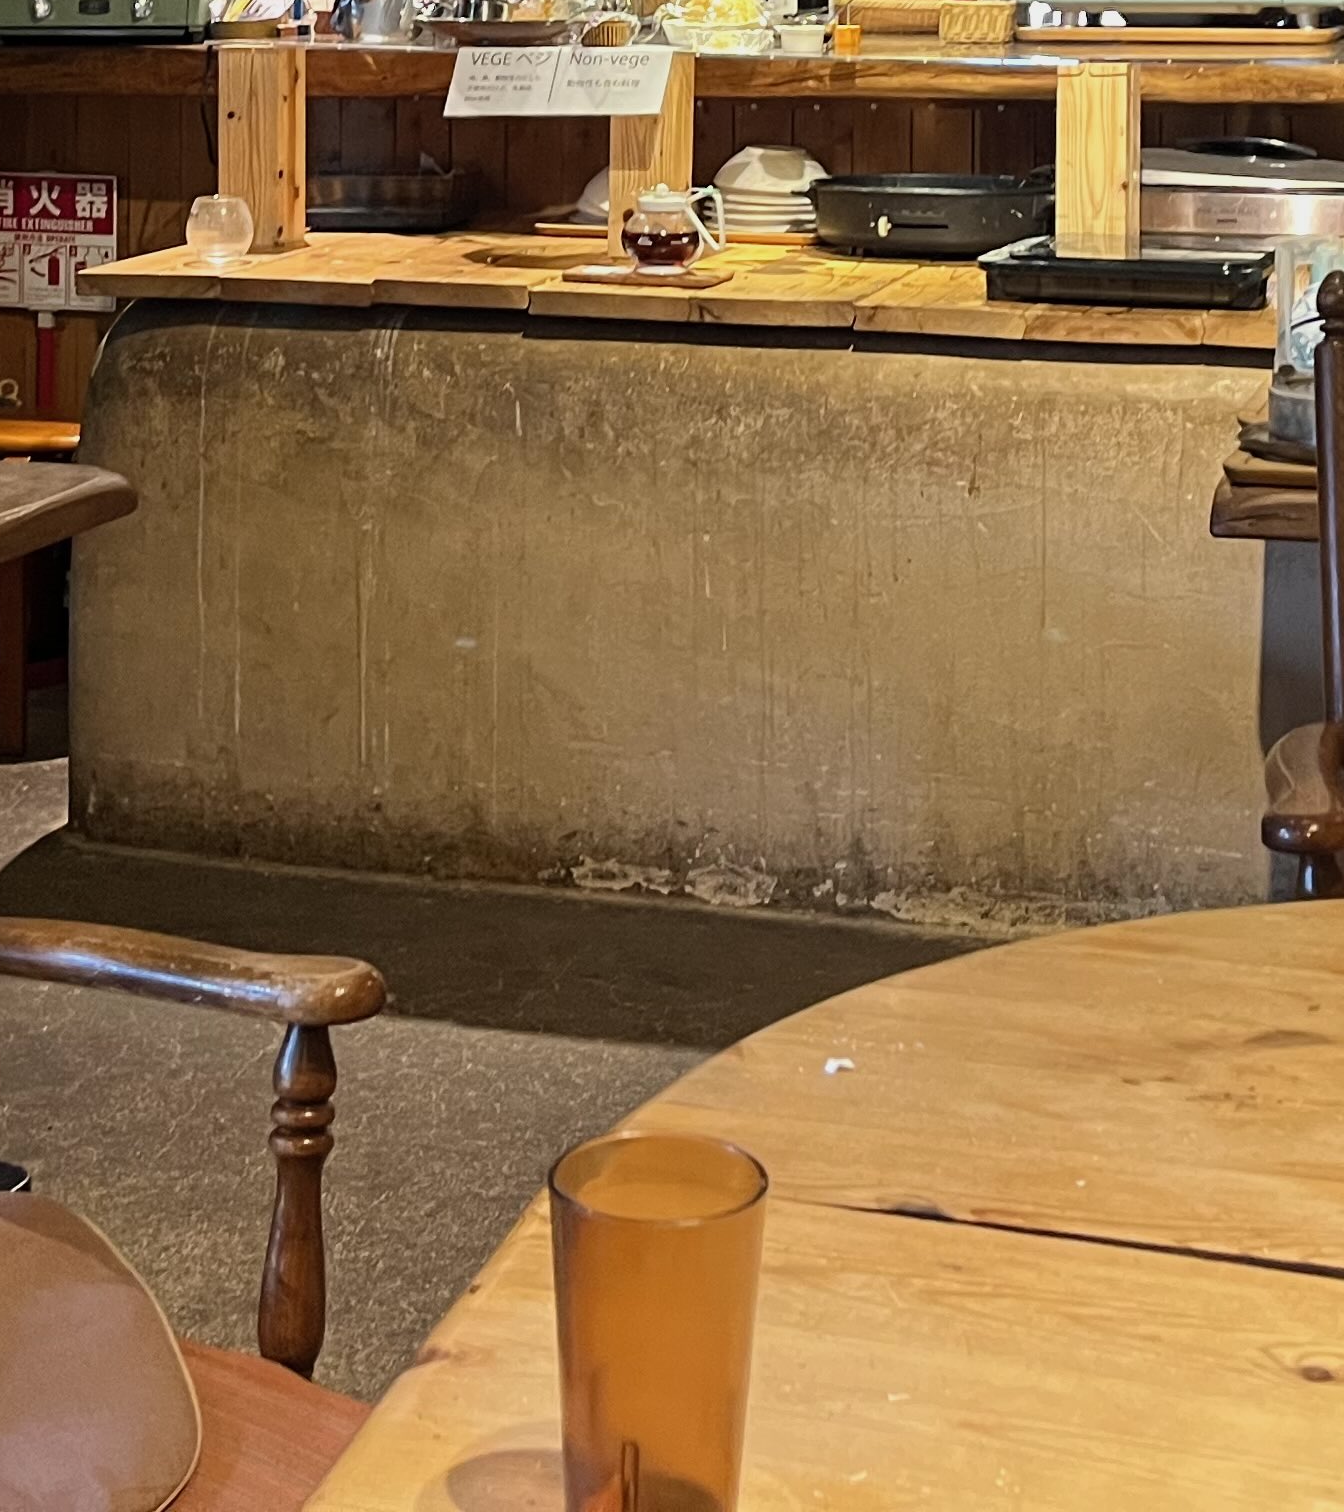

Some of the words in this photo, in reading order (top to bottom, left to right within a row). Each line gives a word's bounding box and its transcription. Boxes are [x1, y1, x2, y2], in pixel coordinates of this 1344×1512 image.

[471, 51, 512, 66] VEGE
[515, 51, 553, 66] ベジ
[569, 50, 650, 69] Non-vege
